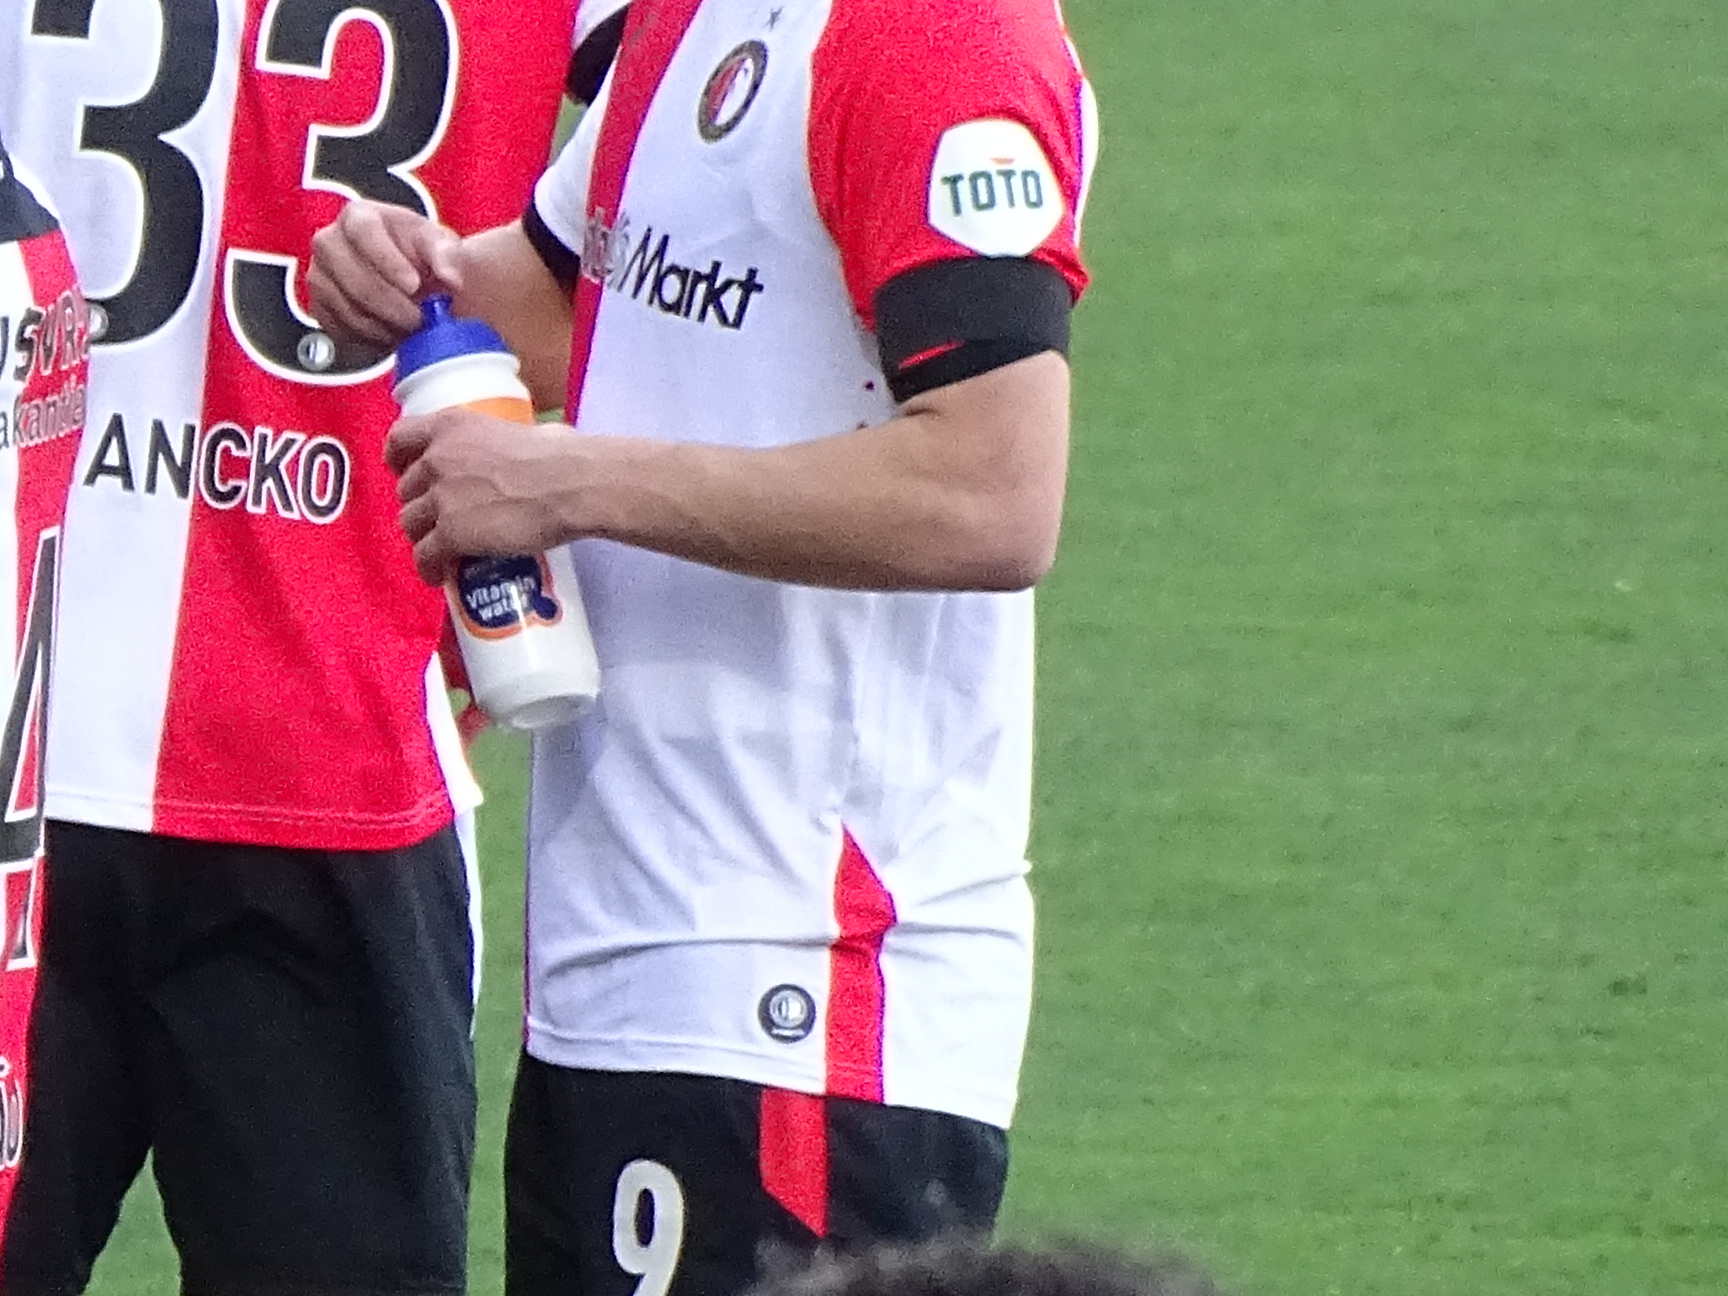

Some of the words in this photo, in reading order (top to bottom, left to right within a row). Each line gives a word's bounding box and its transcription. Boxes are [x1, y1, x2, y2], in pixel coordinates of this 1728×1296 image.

[940, 168, 1044, 217] TOTO
[615, 226, 764, 331] Markt
[83, 412, 350, 523] ANCKO
[478, 593, 529, 621] watr
